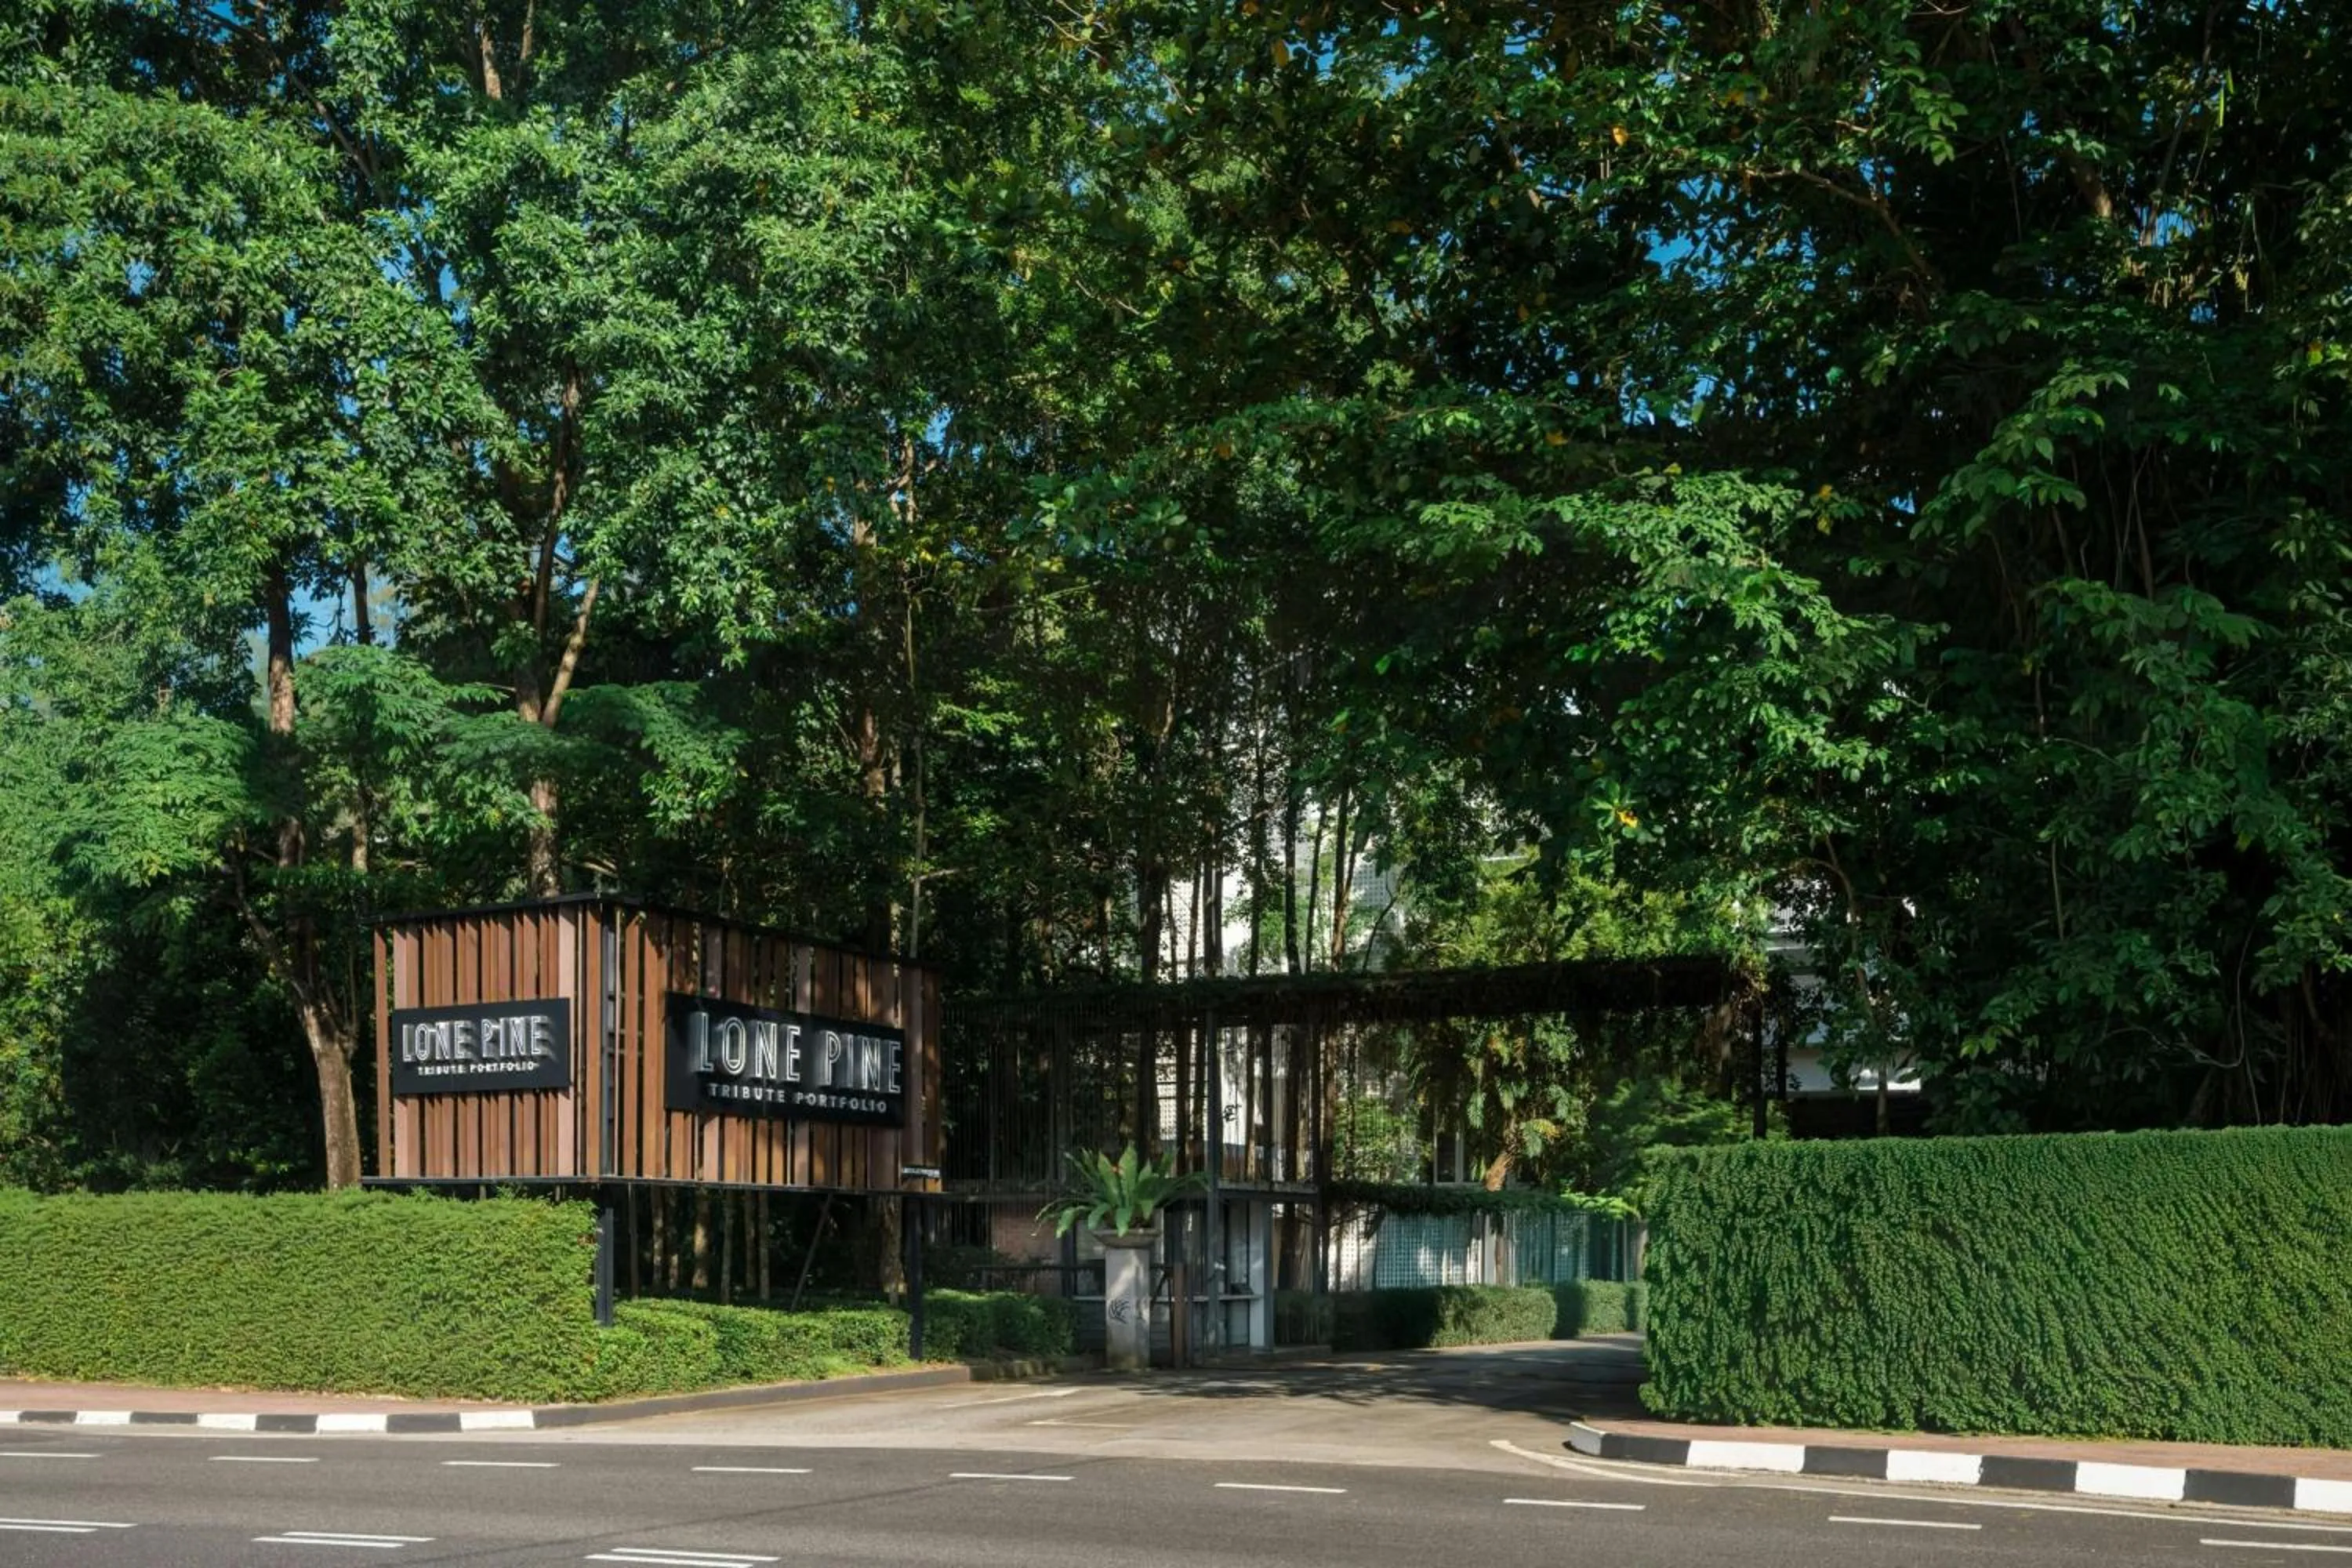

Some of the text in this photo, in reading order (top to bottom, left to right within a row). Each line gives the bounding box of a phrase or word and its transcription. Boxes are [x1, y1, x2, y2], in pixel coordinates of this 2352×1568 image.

[402, 1016, 549, 1062] LONE PINE
[693, 1012, 901, 1094] LONE PINE
[418, 1060, 536, 1076] TRIBUTE PORTFOLIO
[709, 1083, 887, 1113] TRIBUTE PORTFOLIO
